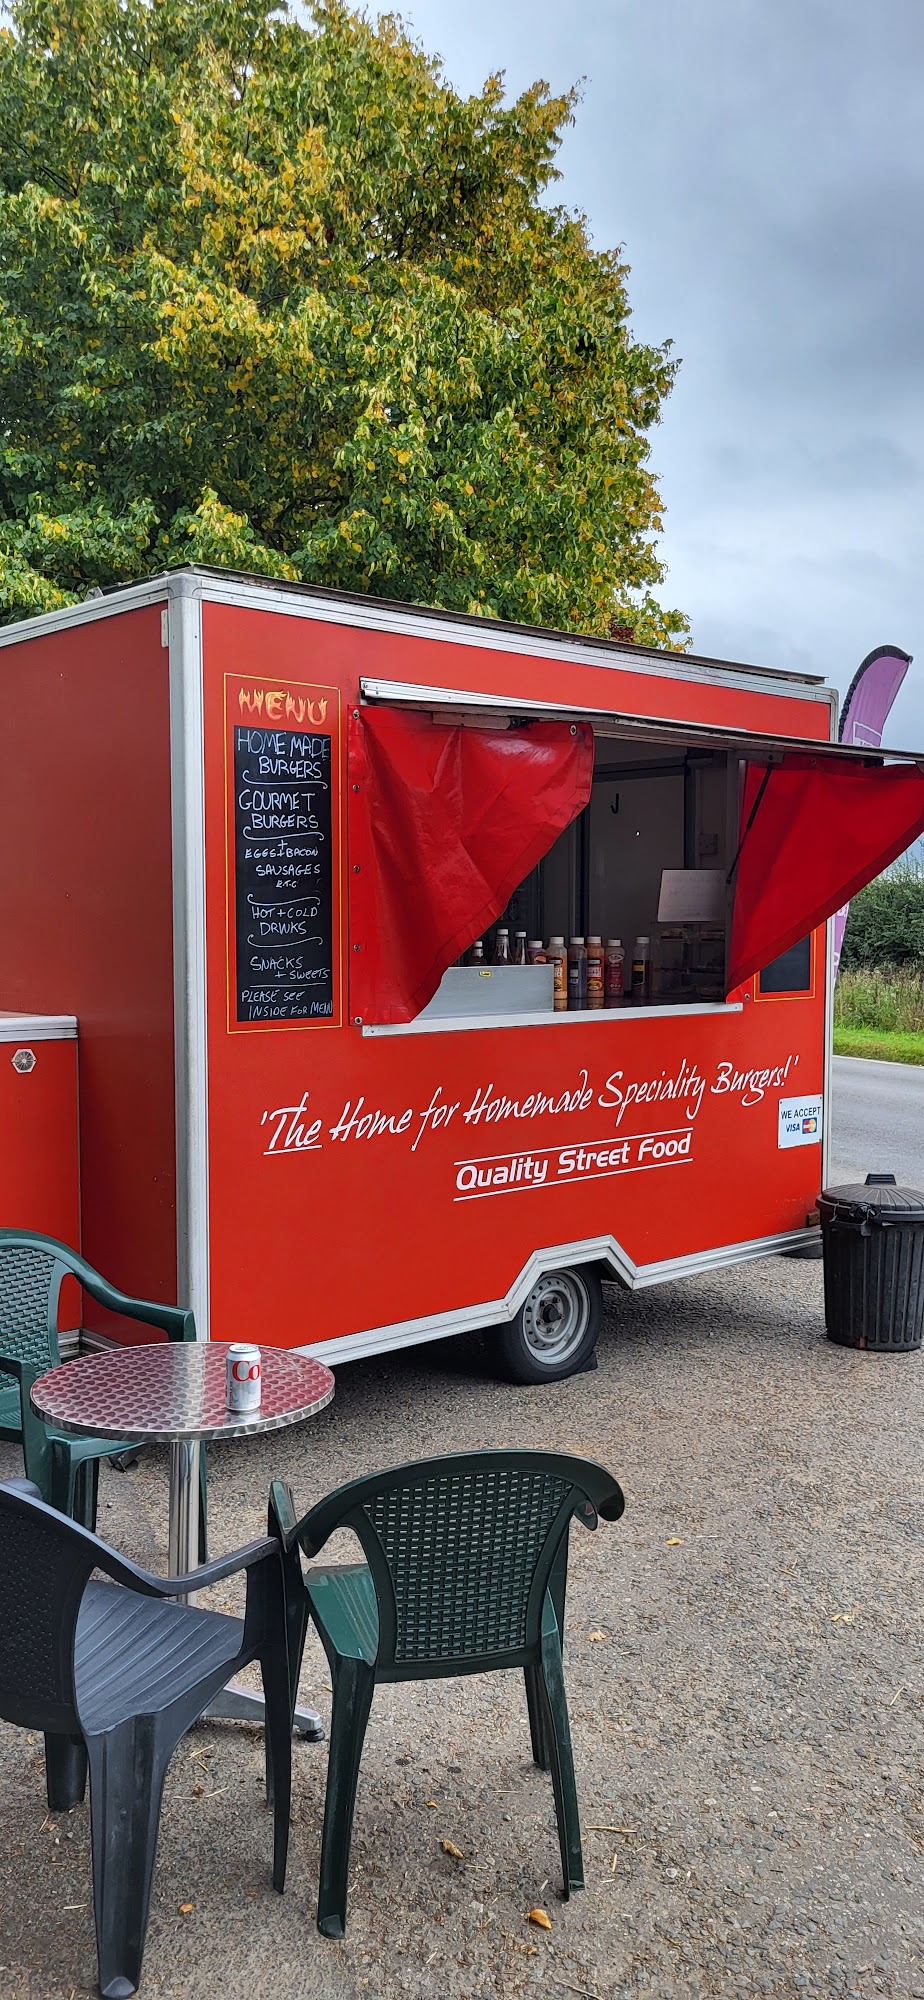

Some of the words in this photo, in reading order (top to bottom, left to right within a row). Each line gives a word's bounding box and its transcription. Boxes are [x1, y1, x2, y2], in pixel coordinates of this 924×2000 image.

[238, 687, 328, 725] MENU
[238, 728, 286, 755] HOME
[289, 735, 331, 759] MADE
[259, 756, 322, 779] BURGERS
[238, 789, 315, 811] GOURMET
[251, 813, 318, 829] BURGERS
[256, 864, 320, 876] SAUSAGES
[250, 956, 303, 971] SNACKS
[329, 1096, 413, 1142] Home
[411, 1086, 461, 1152] for
[463, 1069, 593, 1125] Homemade
[598, 1058, 706, 1127] Speciality
[781, 1110, 792, 1119] WE
[794, 1106, 821, 1118] ACCEPT
[786, 1123, 800, 1132] VISA
[455, 1156, 548, 1191] Quality
[557, 1141, 630, 1175] Street
[637, 1132, 692, 1161] Food
